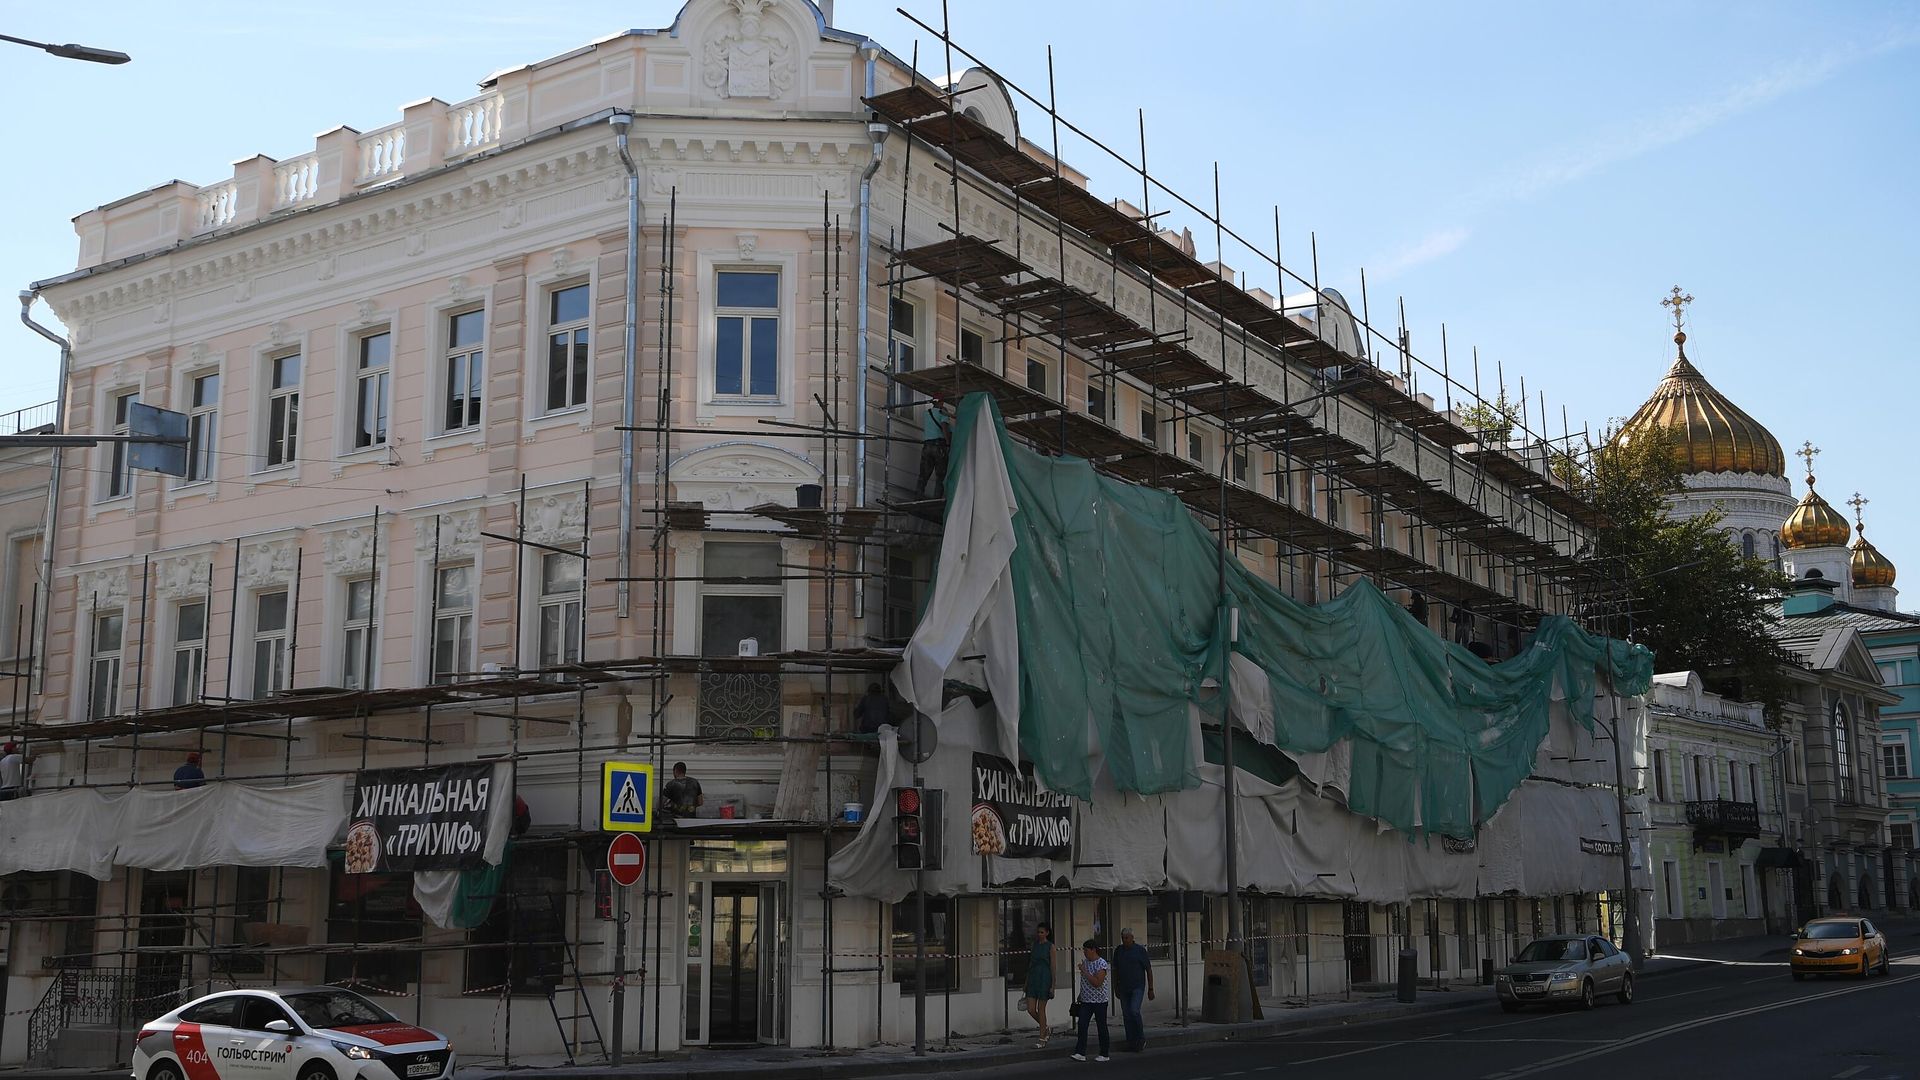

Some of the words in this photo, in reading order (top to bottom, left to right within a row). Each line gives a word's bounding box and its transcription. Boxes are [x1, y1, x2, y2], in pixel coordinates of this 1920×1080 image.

[356, 777, 489, 817] ХИНКАЛЬНАЯ
[386, 822, 481, 856] «ТРИУМФ»
[1595, 843, 1612, 853] COSTA
[186, 1049, 208, 1064] 404
[217, 1047, 286, 1063] ГОЛЬФСТРИМ
